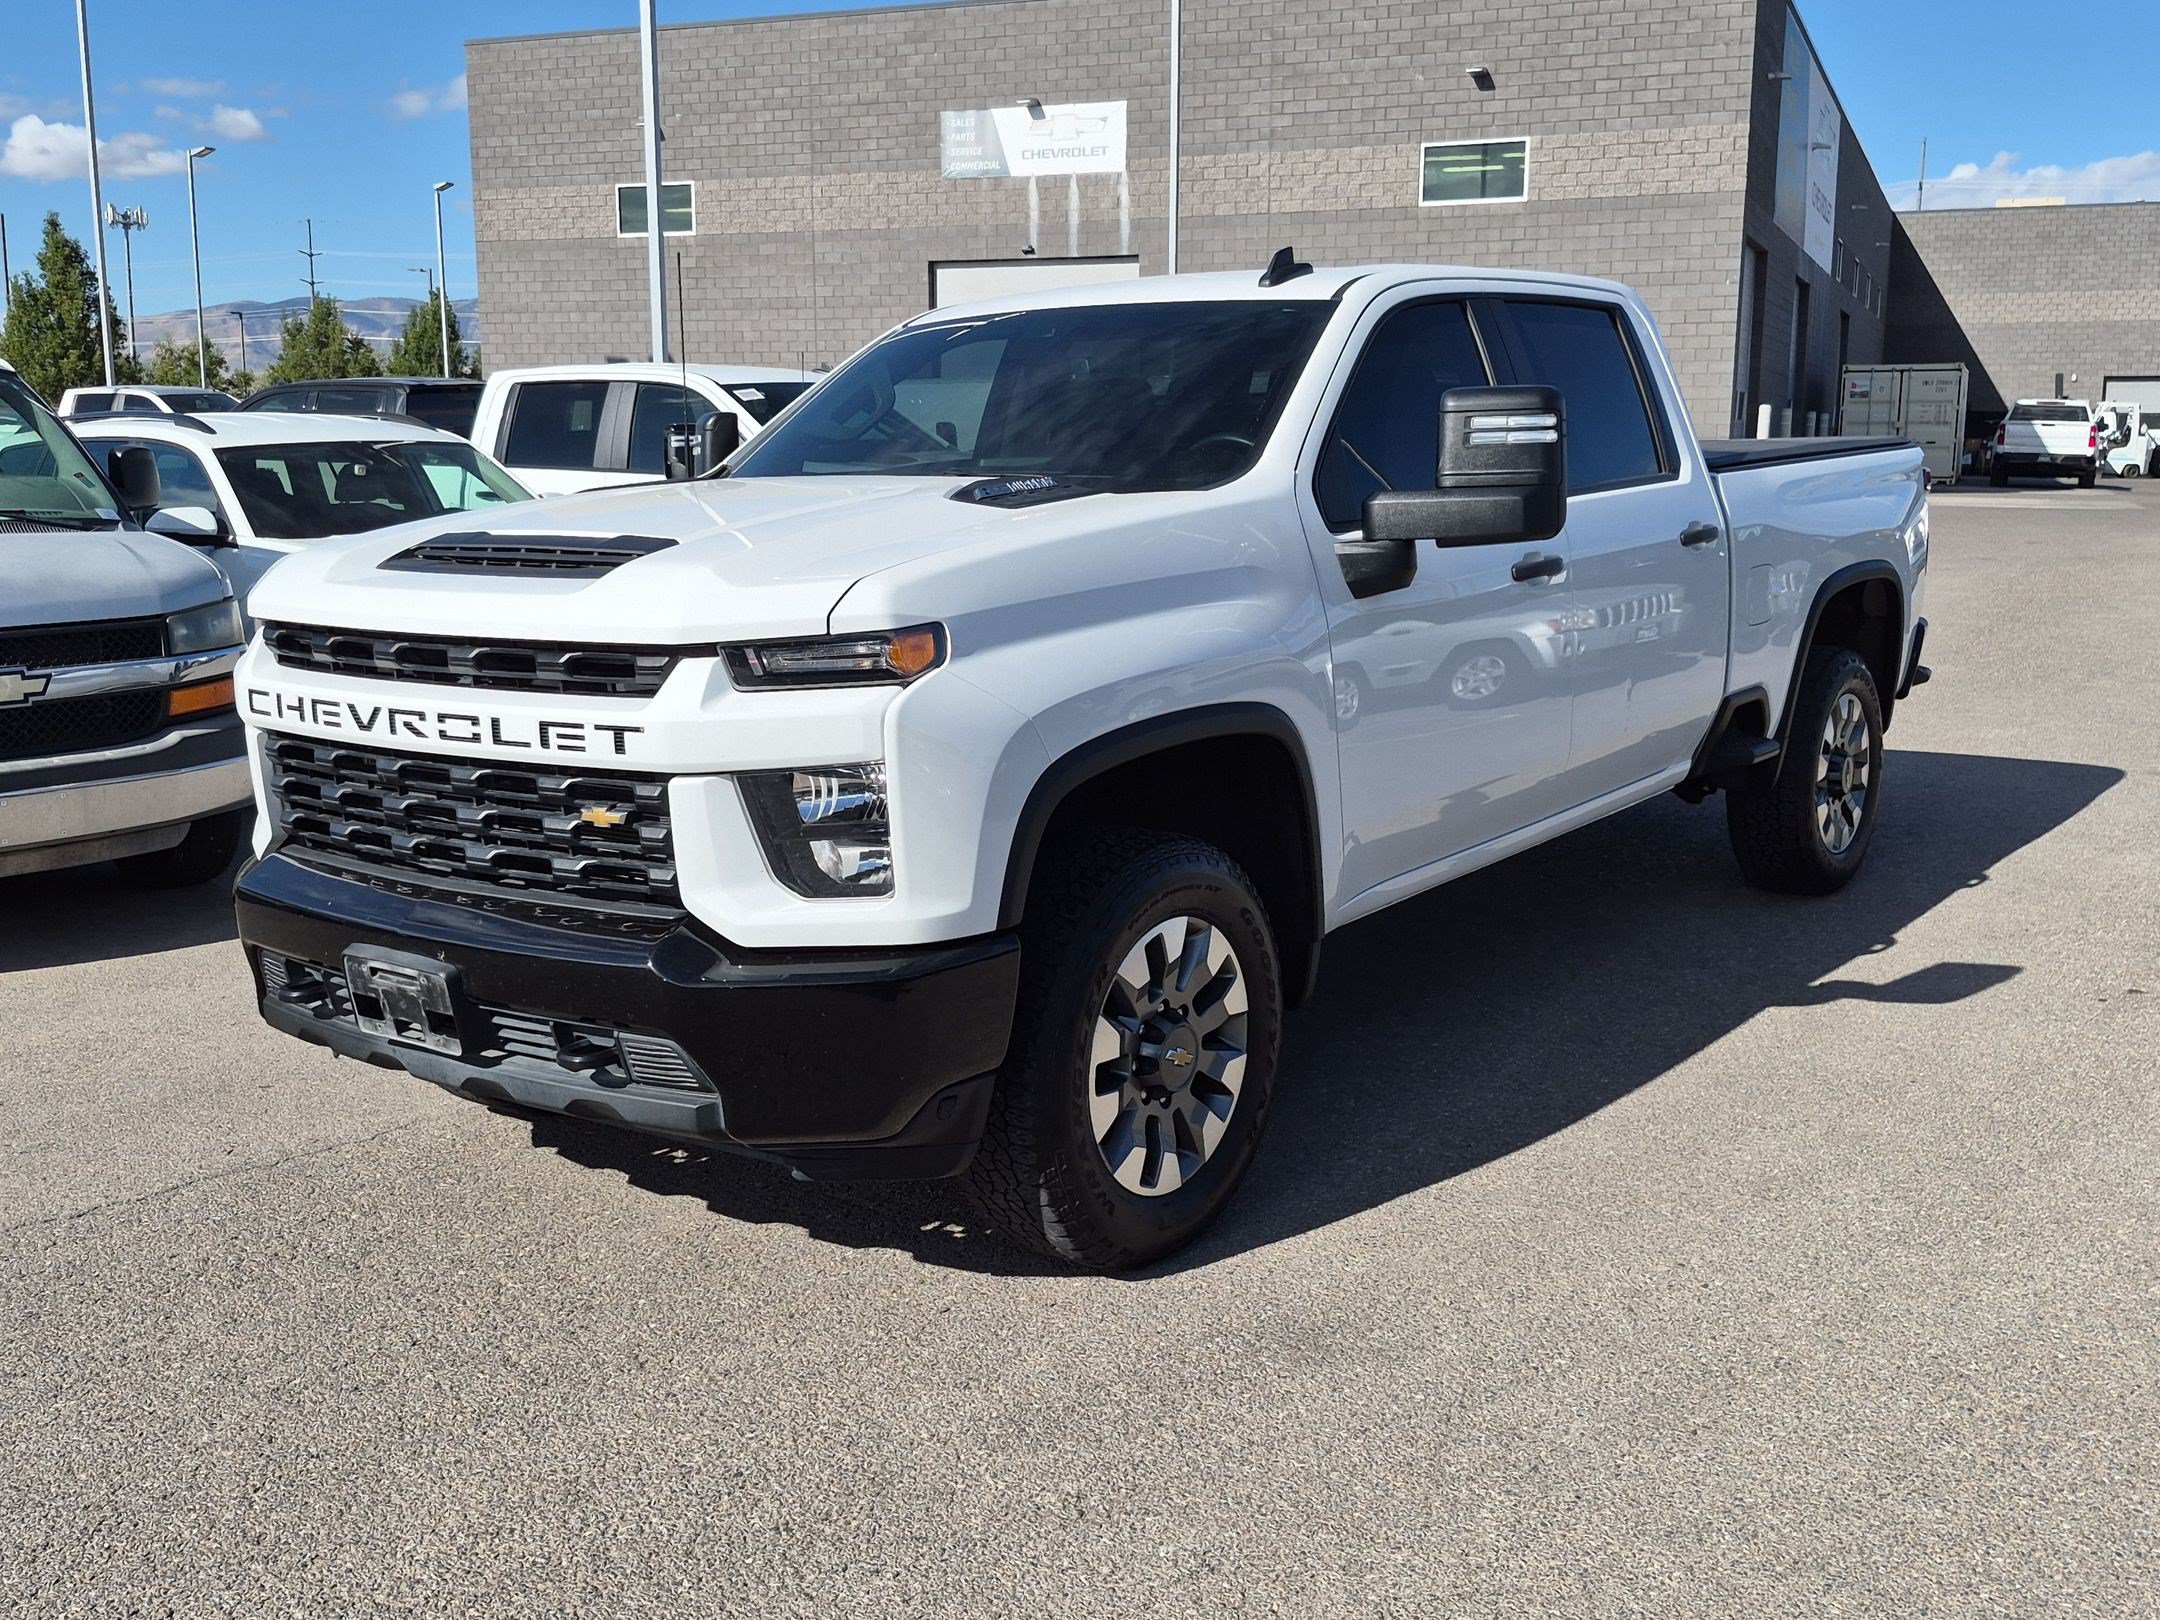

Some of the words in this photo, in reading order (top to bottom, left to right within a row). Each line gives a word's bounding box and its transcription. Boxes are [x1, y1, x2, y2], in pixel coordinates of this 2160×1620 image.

[951, 118, 975, 127] SALES
[951, 132, 975, 141] PARTS
[951, 147, 983, 156] SERVICE
[1022, 146, 1108, 160] CHEVROLET
[950, 160, 1001, 171] COMMERCIAL
[247, 688, 645, 755] CHEVROLET
